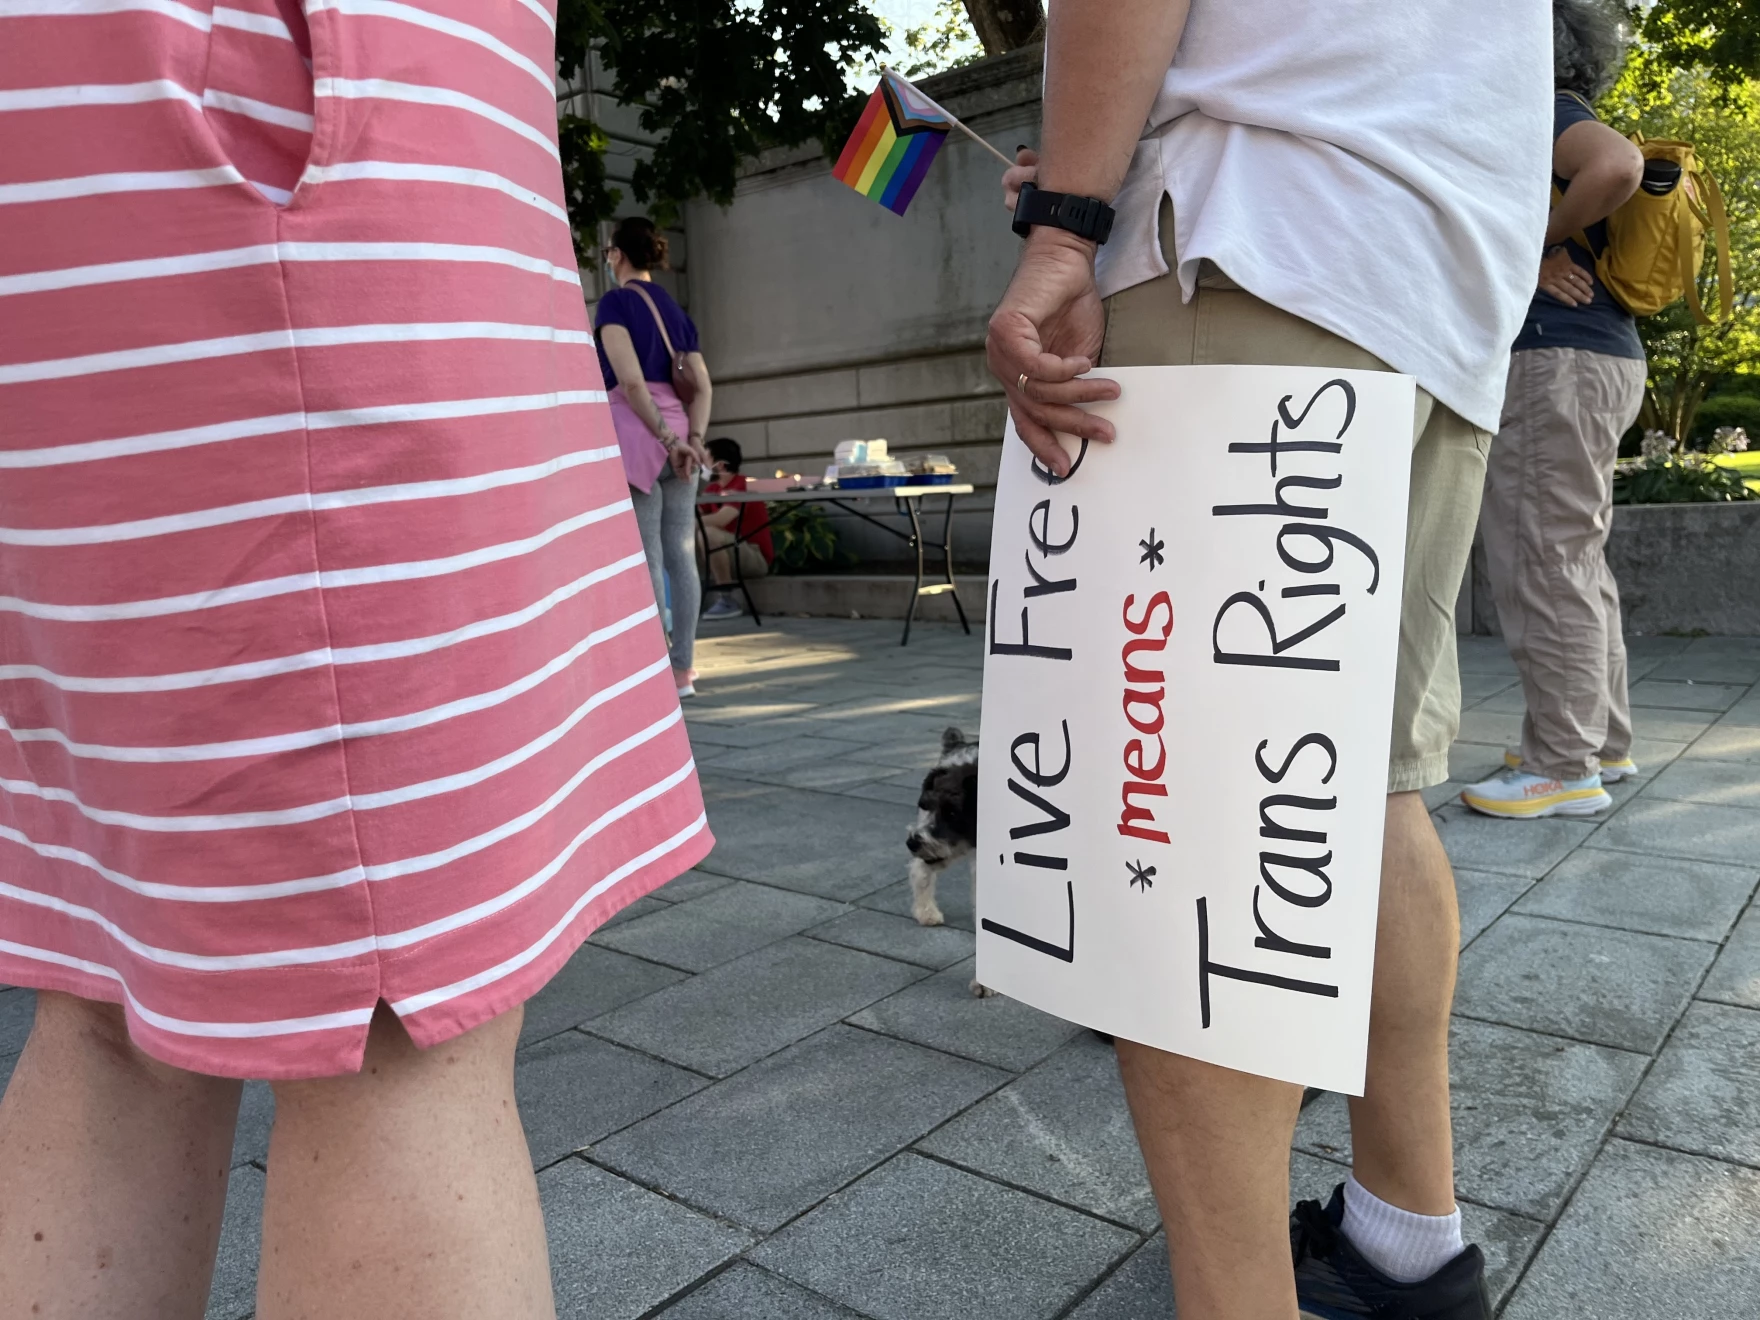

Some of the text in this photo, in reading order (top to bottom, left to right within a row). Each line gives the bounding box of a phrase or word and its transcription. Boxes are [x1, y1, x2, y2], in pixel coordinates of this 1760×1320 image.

[1195, 378, 1380, 1030] Trans Rights
[1523, 779, 1564, 796] HOKA
[981, 718, 1075, 964] Live
